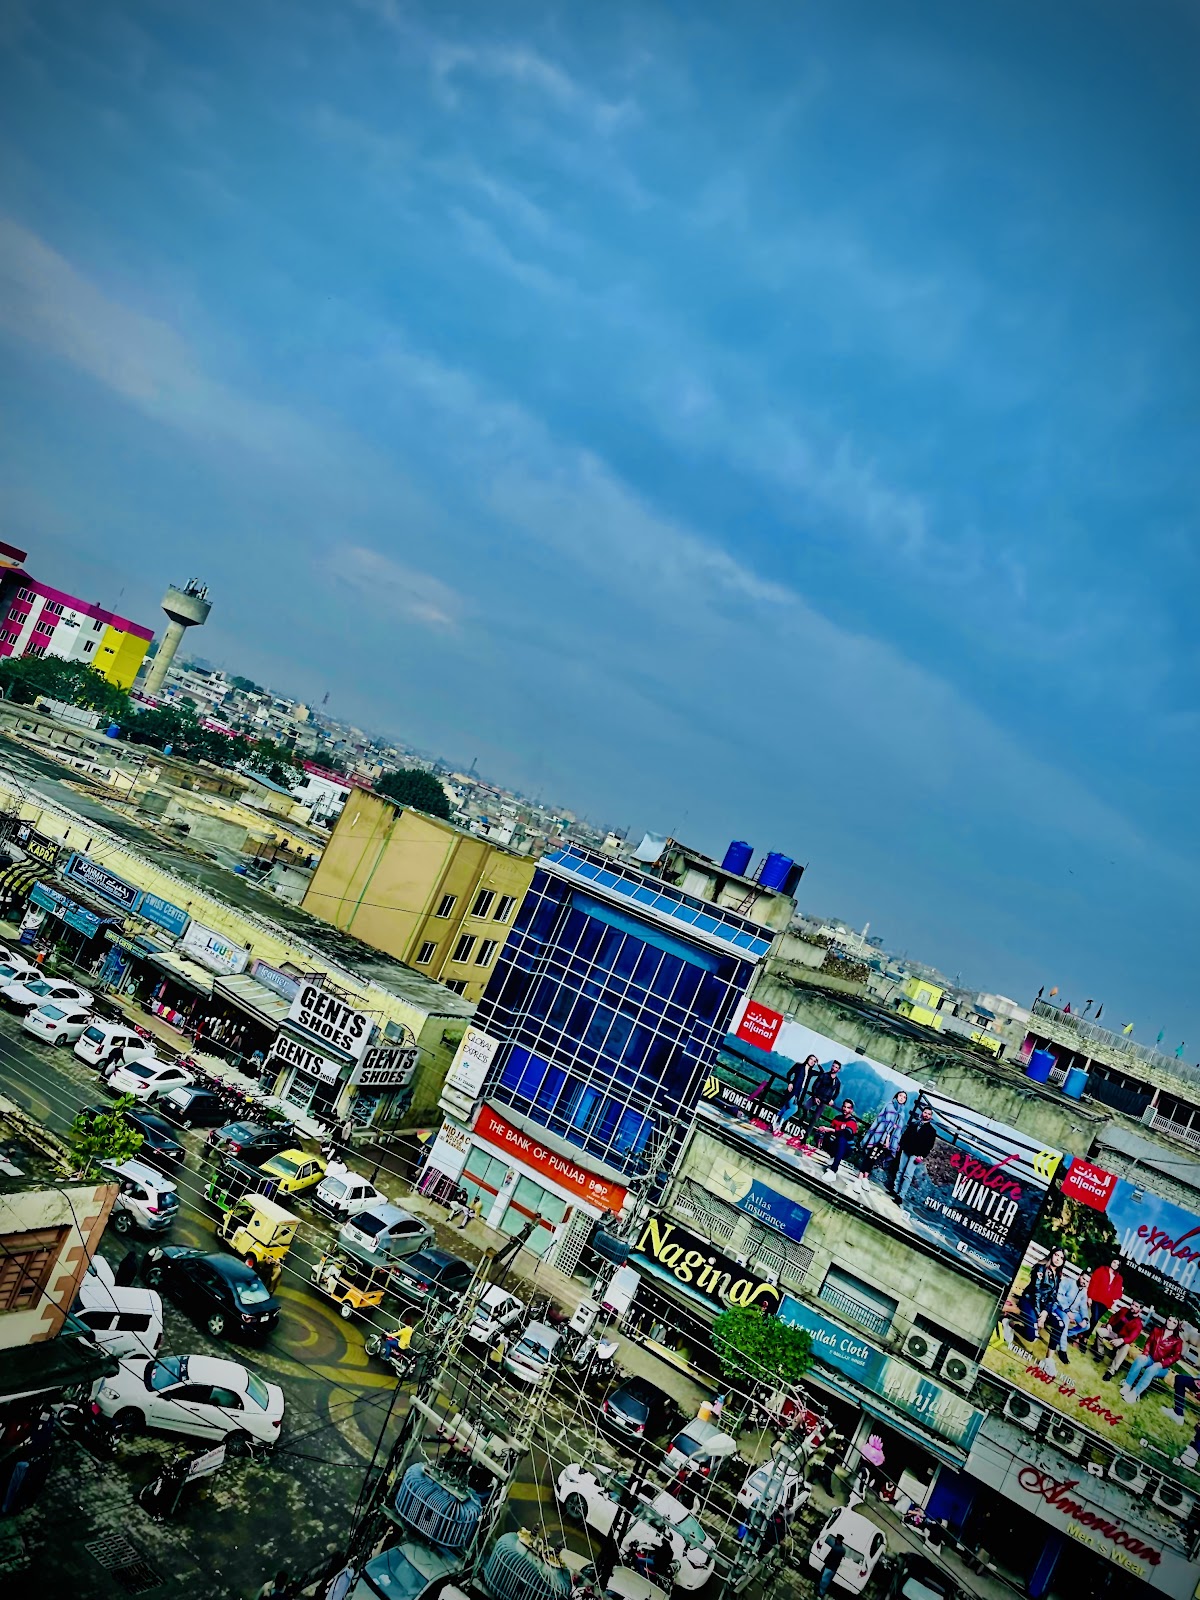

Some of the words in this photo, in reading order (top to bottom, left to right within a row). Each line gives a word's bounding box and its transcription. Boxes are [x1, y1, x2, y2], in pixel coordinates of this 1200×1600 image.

[28, 841, 55, 863] KAPRA
[79, 861, 108, 884] RAHMAT
[146, 893, 165, 911] SWISS
[163, 903, 187, 923] CENTER
[300, 986, 366, 1038] GENTS
[298, 1010, 353, 1051] SHOES
[467, 1031, 493, 1052] GLOBAL
[743, 1020, 773, 1039] aljanat
[275, 1037, 324, 1076] GENTS
[362, 1048, 418, 1070] GENTS
[462, 1044, 489, 1064] EXPRESS
[319, 1072, 335, 1084] SHOES
[359, 1070, 405, 1084] SHOES
[722, 1087, 754, 1112] WOMEN
[758, 1107, 779, 1127] MEN
[784, 1121, 807, 1140] KIDS
[488, 1119, 505, 1136] THE
[505, 1129, 533, 1152] BANK
[533, 1147, 548, 1161] OF
[548, 1156, 586, 1185] PUNJAB
[588, 1179, 608, 1196] BOP
[950, 1153, 1022, 1200] explore
[1069, 1175, 1107, 1198] aljanat
[747, 1192, 772, 1211] Atlas
[951, 1172, 1019, 1228] WINTER
[924, 1196, 942, 1212] STAY
[941, 1205, 963, 1223] WARM
[962, 1216, 969, 1227] &
[969, 1220, 1006, 1247] VERSATILE
[985, 1219, 1009, 1237] 21-22
[1119, 1227, 1198, 1291] WINTER
[1137, 1224, 1200, 1270] explor
[635, 1217, 779, 1308] Nagina
[1126, 1259, 1138, 1270] STAY
[1137, 1265, 1152, 1278] WARM
[1163, 1279, 1187, 1296] VERSATILE
[1163, 1287, 1186, 1303] 21-22
[839, 1339, 869, 1360] Cloth
[1006, 1342, 1033, 1363] WOMEN
[1018, 1467, 1161, 1566] American
[1110, 1547, 1147, 1576] Wear
